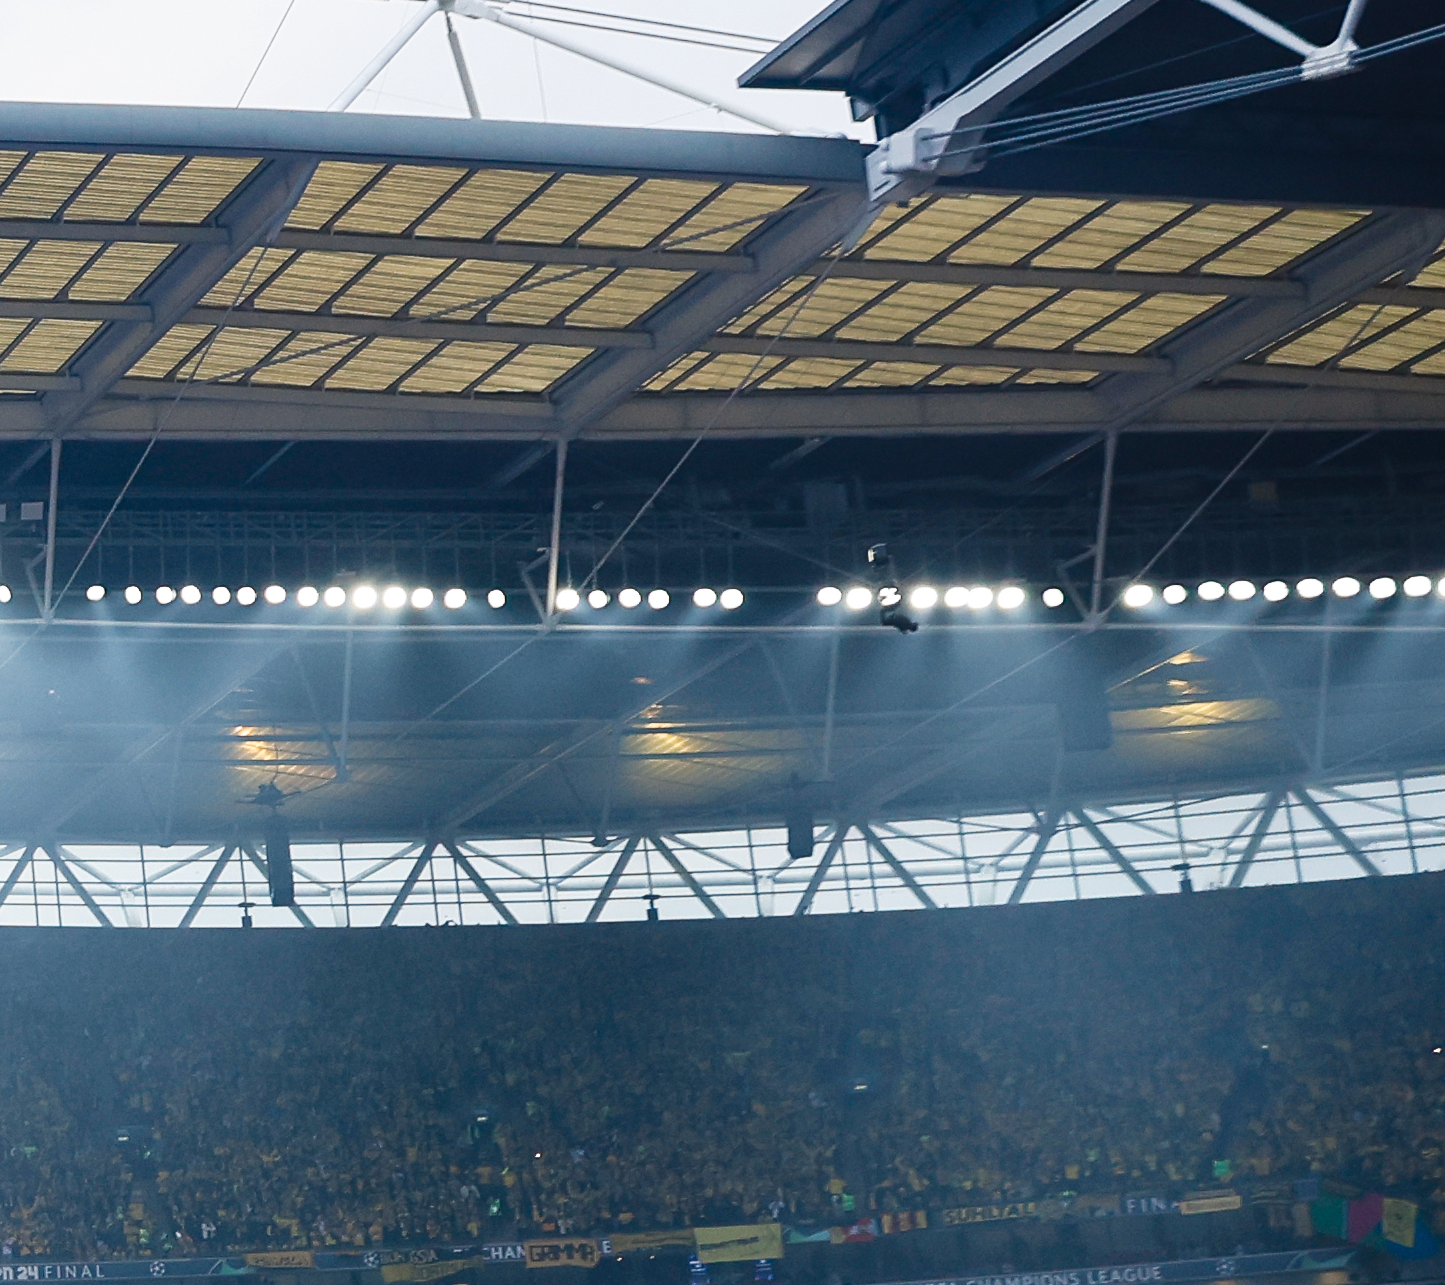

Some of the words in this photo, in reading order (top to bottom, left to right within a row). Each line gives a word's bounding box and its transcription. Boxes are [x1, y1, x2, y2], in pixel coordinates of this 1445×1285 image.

[17, 1264, 39, 1280] 24
[44, 1263, 104, 1279] FINAL
[1086, 1266, 1162, 1285] LEAGUE
